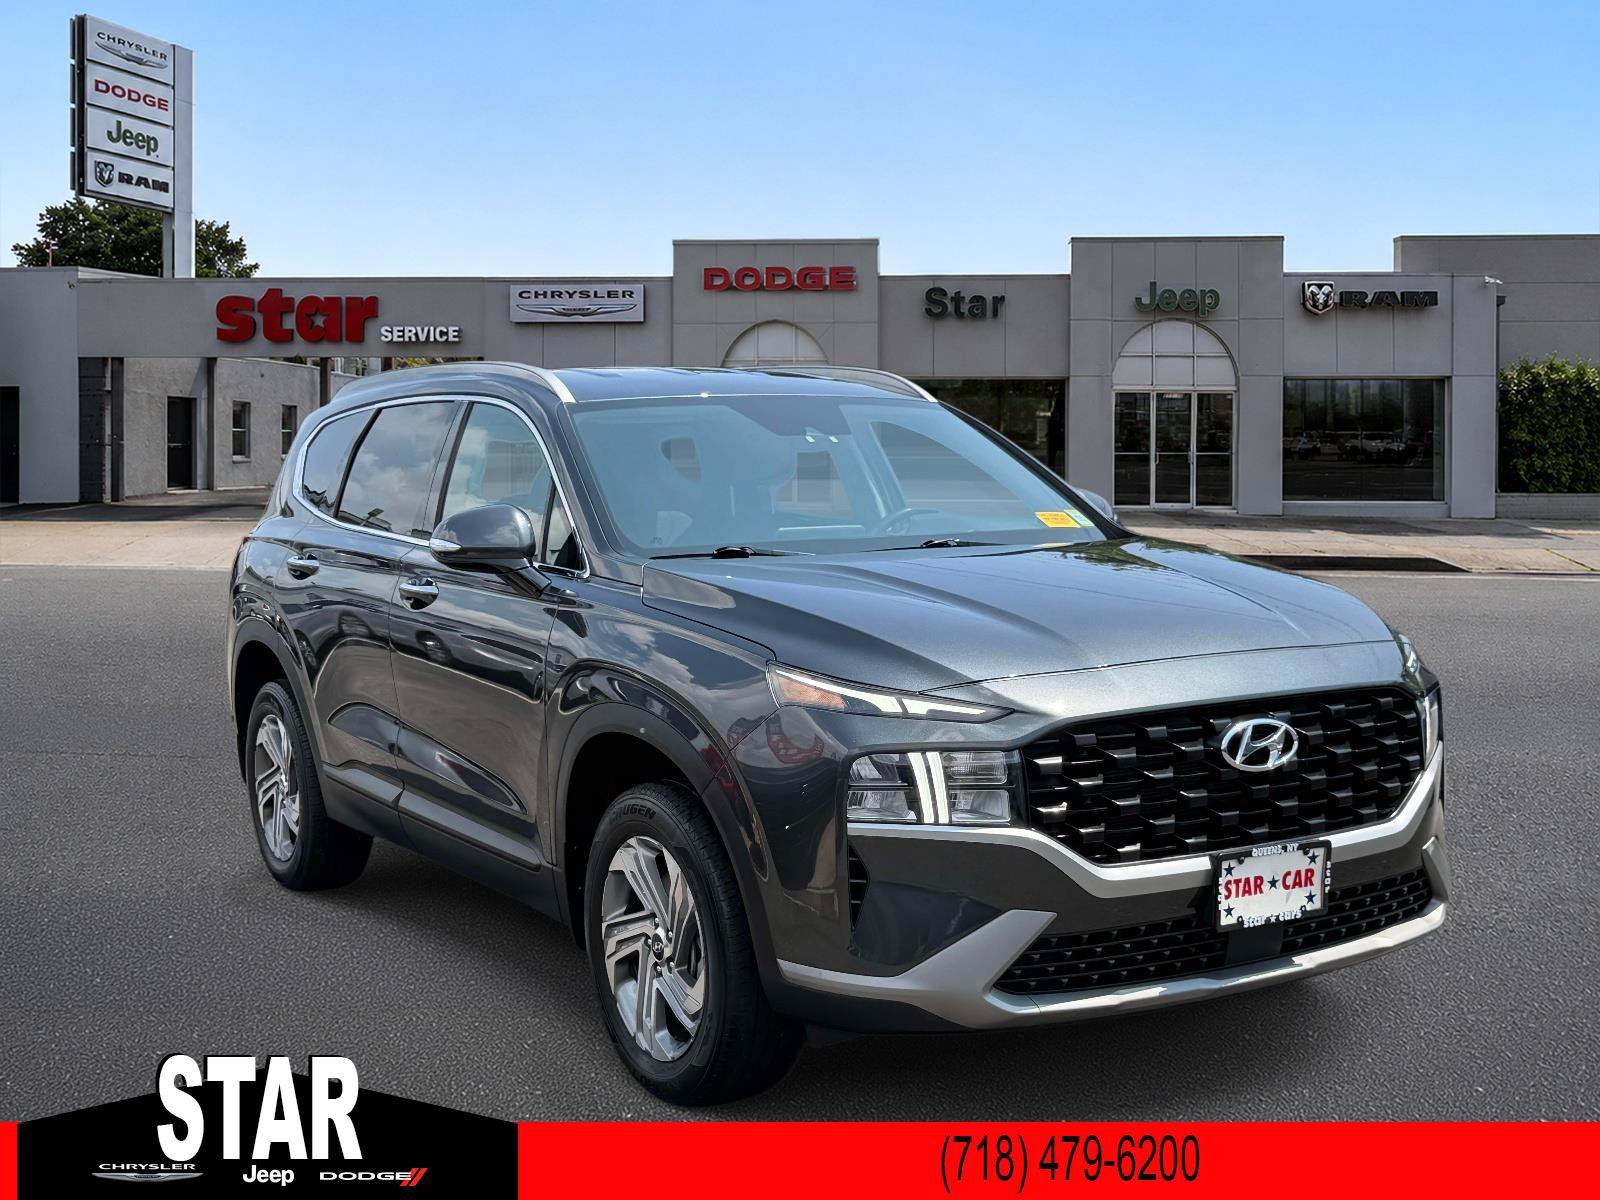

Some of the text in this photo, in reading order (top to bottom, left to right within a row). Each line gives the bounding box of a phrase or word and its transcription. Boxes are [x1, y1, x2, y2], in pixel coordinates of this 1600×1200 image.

[97, 31, 168, 62] CHRYSLER
[94, 79, 169, 112] DODGE
[106, 120, 159, 157] Jeep
[118, 172, 170, 193] RAM
[703, 265, 857, 291] DODGE
[517, 289, 636, 300] CHRYSLER
[923, 286, 1006, 320] Star
[1135, 280, 1220, 317] Jeep
[1340, 290, 1439, 308] RAM
[215, 287, 378, 344] star
[380, 325, 461, 343] SERVICE
[1223, 875, 1264, 901] STAR
[1281, 867, 1315, 891] CAR
